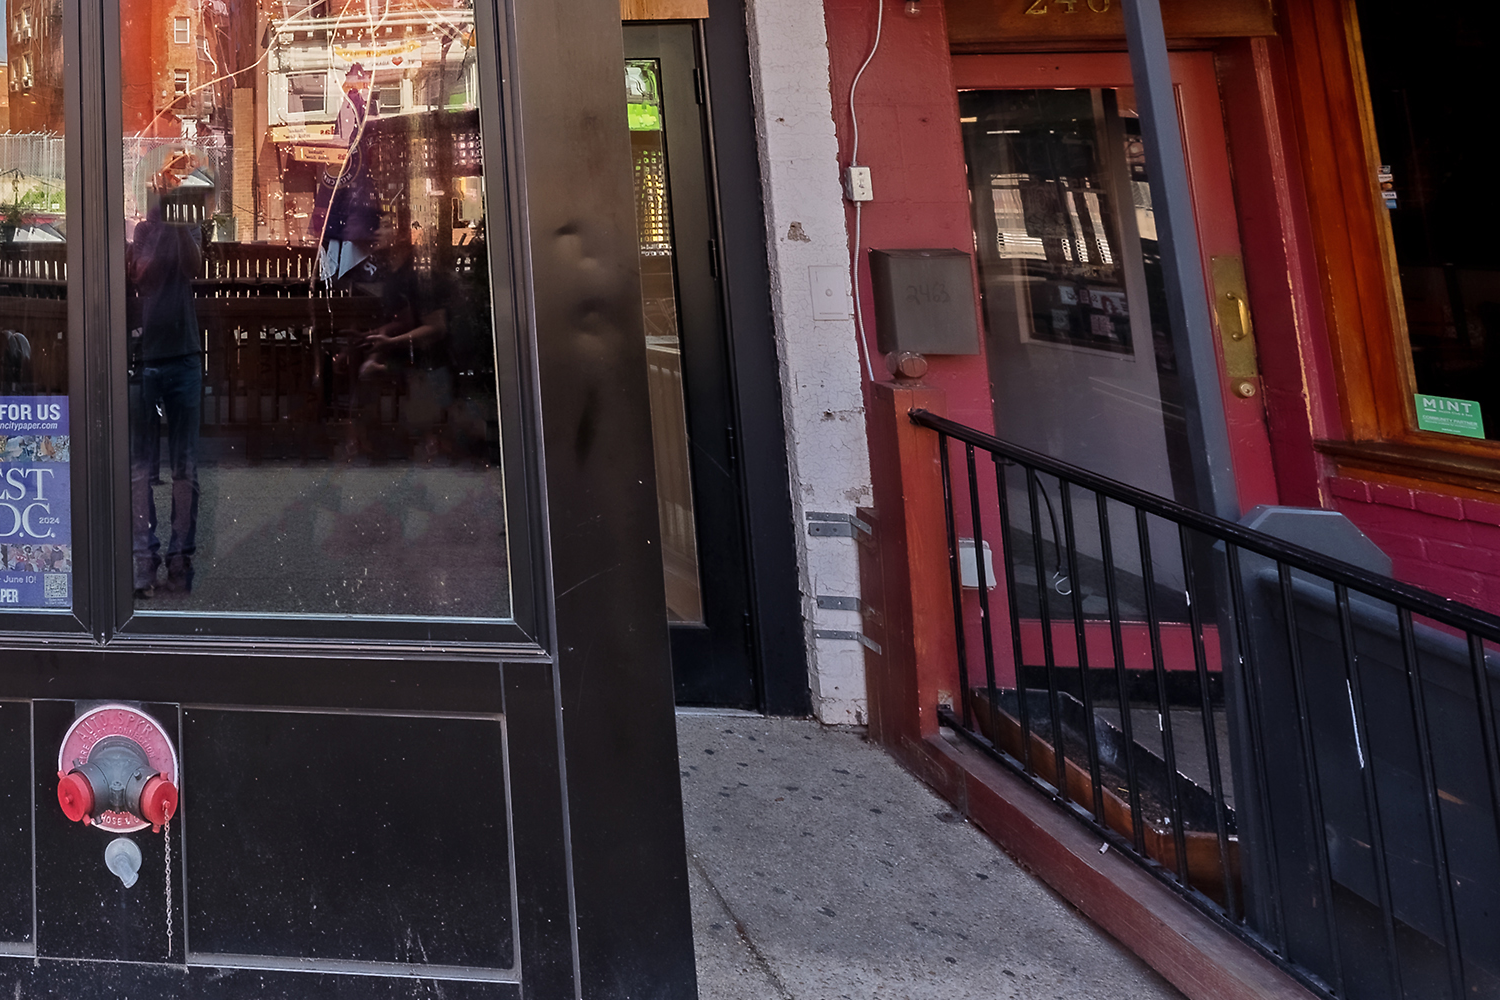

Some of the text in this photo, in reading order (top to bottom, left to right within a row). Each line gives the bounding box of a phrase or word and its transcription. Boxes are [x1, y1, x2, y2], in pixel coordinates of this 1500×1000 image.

[37, 403, 61, 420] US
[1422, 398, 1472, 413] MINT
[3, 575, 24, 583] June
[25, 575, 37, 583] 10!
